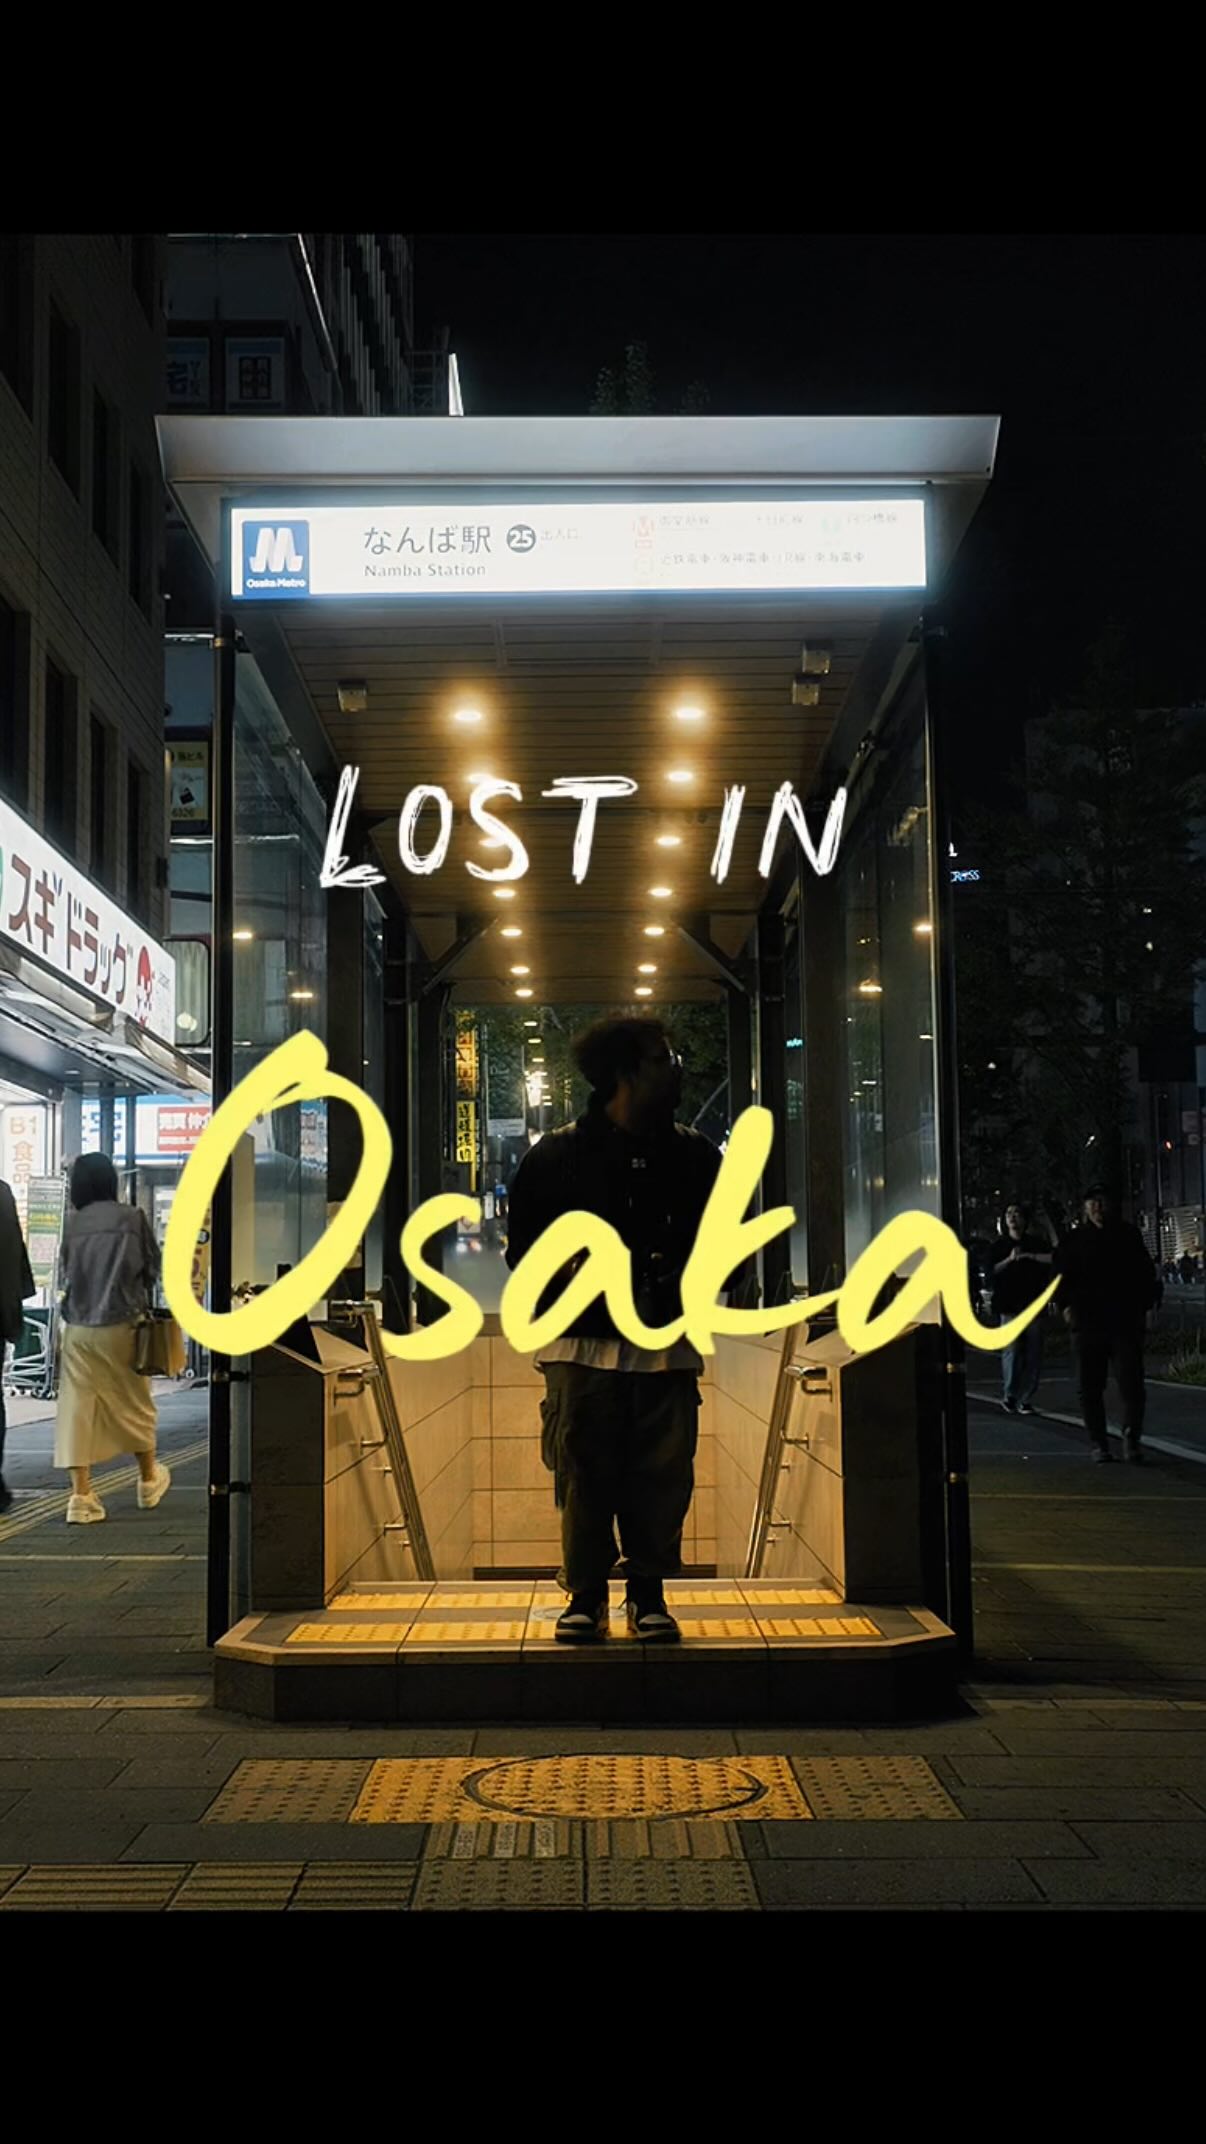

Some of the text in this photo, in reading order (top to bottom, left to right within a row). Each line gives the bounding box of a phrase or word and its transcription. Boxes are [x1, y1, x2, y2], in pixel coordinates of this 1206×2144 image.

[364, 524, 492, 556] なんば駅
[508, 528, 535, 551] 25
[364, 562, 486, 577] Namba Station
[246, 577, 306, 589] Osaka Metro
[8, 852, 133, 1005] スギドラッグ
[10, 1115, 37, 1136] B1
